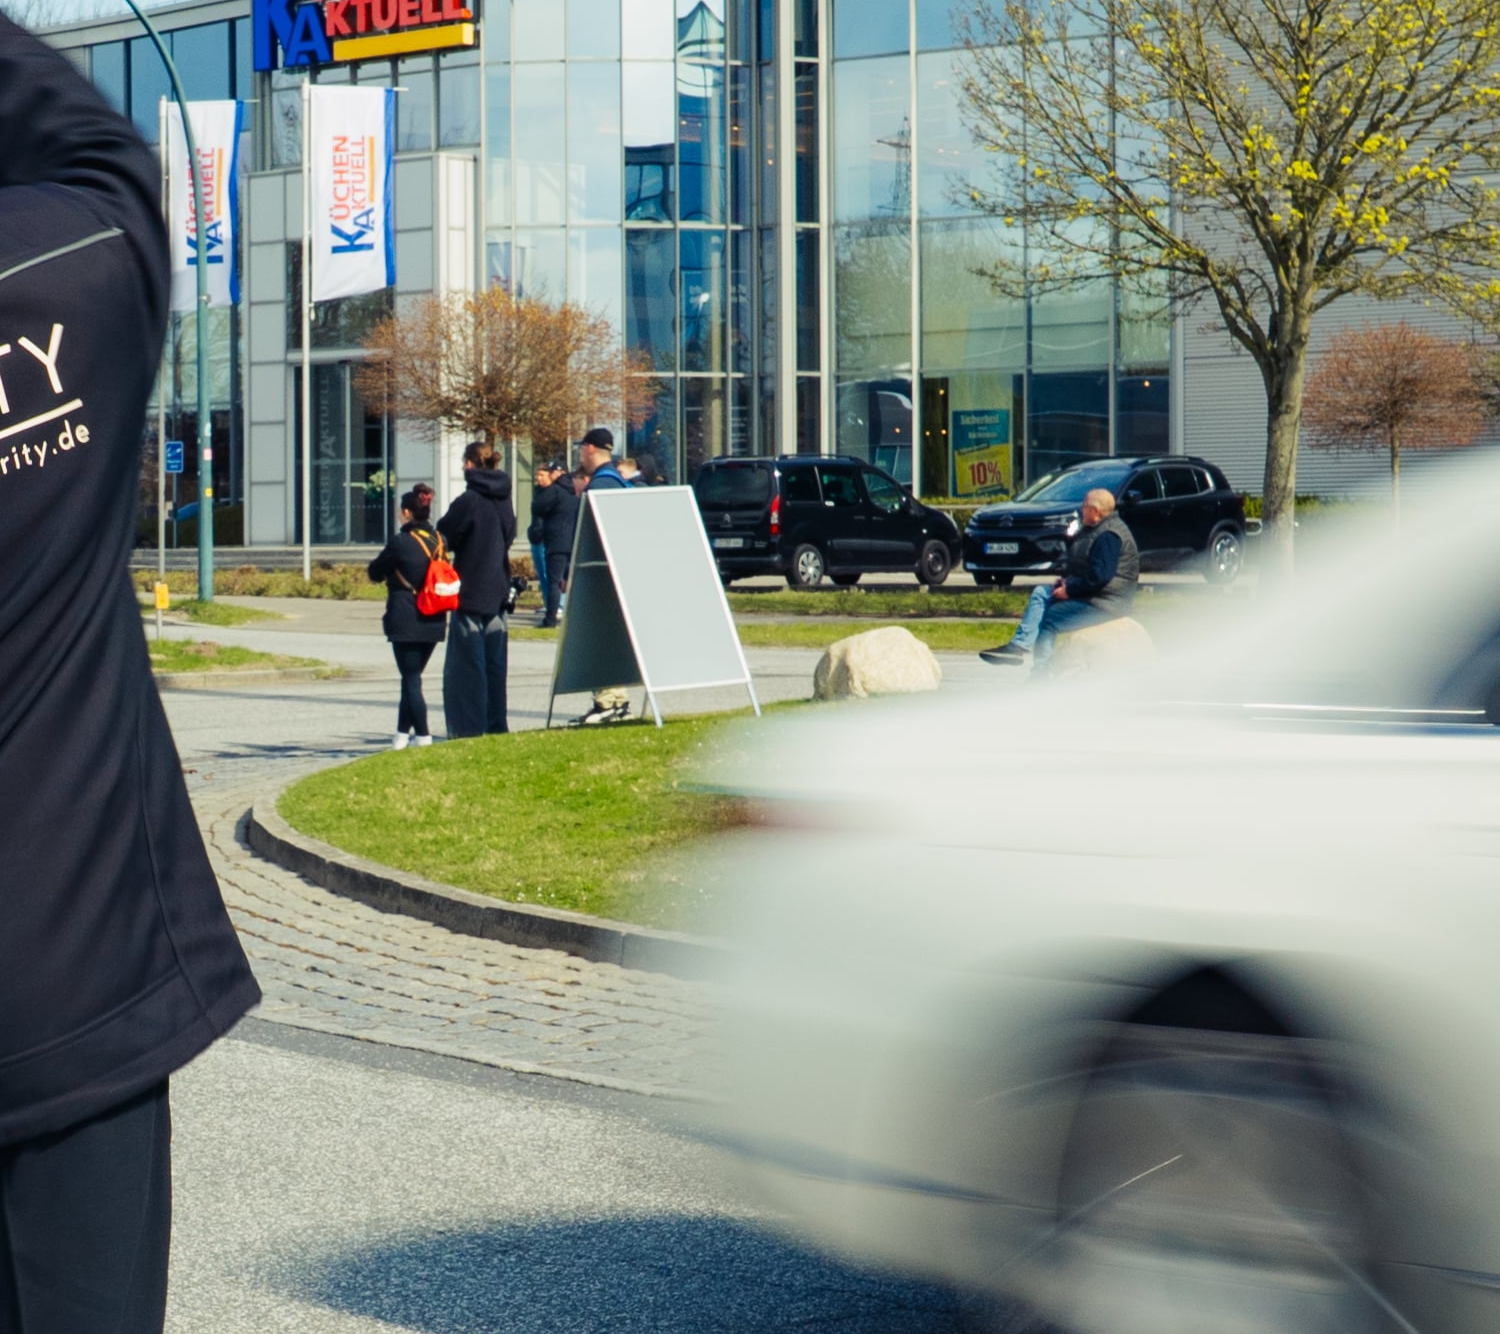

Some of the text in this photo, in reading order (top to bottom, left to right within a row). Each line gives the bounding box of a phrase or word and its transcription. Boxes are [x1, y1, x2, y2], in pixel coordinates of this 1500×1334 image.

[329, 135, 374, 254] KÜCHEN
[350, 135, 375, 231] AKTUELL
[969, 460, 1002, 486] 10%
